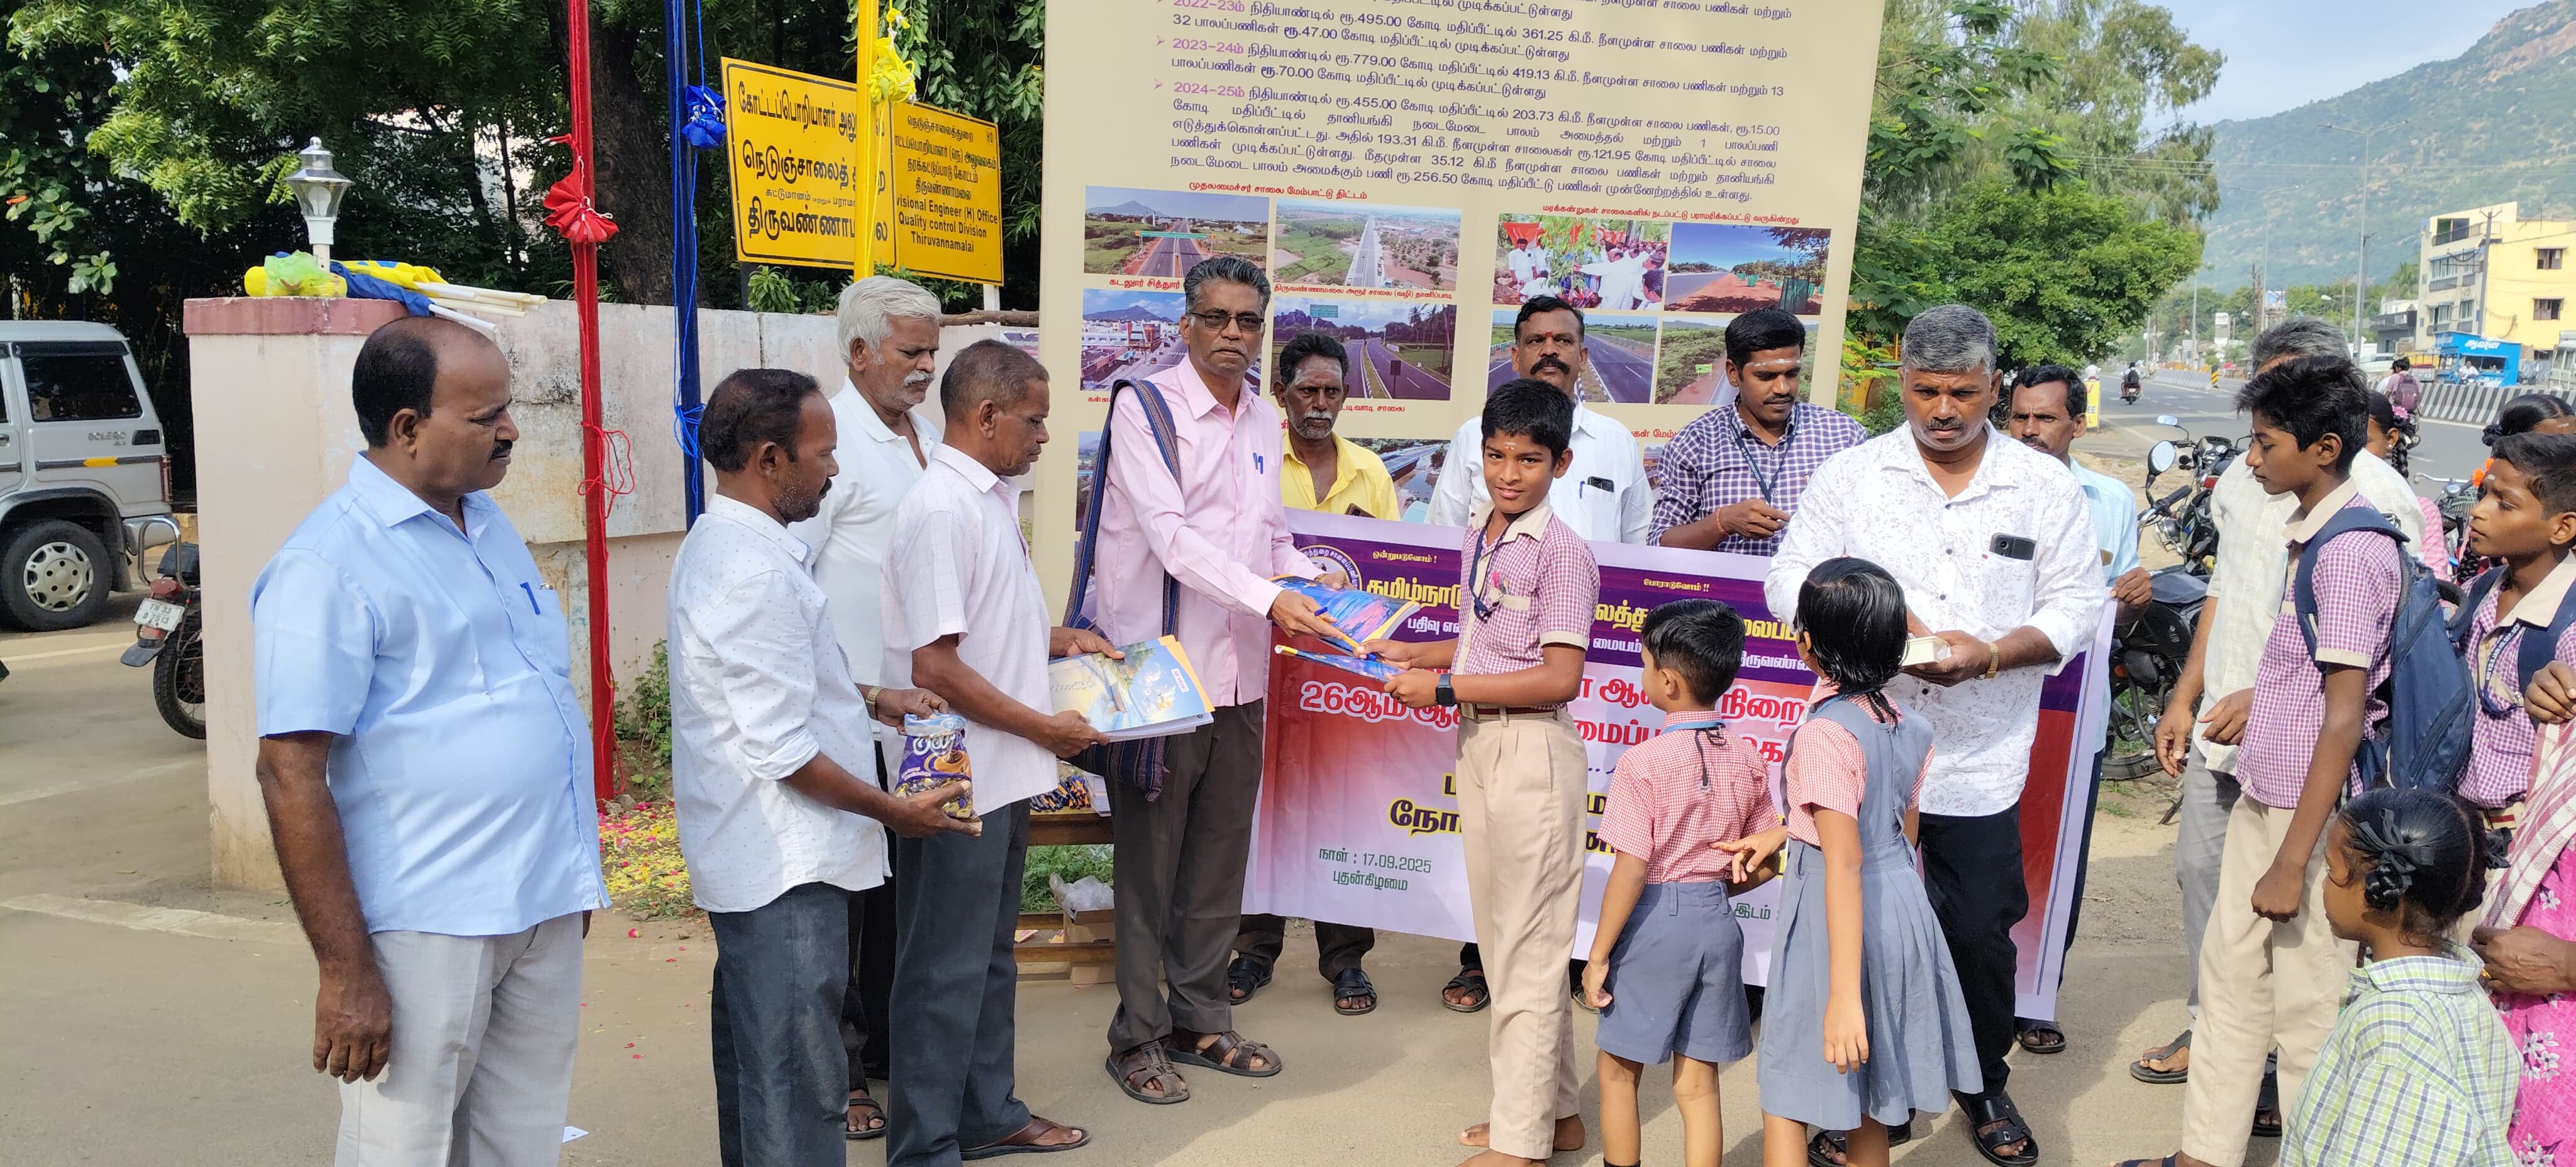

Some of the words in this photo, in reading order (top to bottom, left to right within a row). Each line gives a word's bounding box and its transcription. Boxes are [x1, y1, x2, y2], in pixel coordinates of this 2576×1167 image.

[1706, 1, 1749, 14] பணிகள்
[1754, 6, 1791, 20] மற்றும்
[1173, 14, 1191, 25] 32
[1195, 18, 1279, 33] பாலப்பணிகள்
[1340, 28, 1375, 43] கோடி
[1380, 33, 1451, 50] மதிப்பீட்டில்
[1250, 1, 1334, 21] நிதியாண்டில்
[1407, 16, 1441, 32] கோடி
[1447, 21, 1516, 38] மதிப்பீட்டில்
[1523, 28, 1563, 41] 361.25
[1599, 33, 1655, 49] நீளமுள்ள
[1660, 41, 1696, 51] சாலை
[1702, 42, 1745, 55] பணிகள்
[1750, 47, 1787, 60] மற்றும்
[1172, 58, 1257, 73] பாலப்பணிகள்
[1318, 67, 1352, 83] கோடி
[1357, 72, 1427, 89] மதிப்பீட்டில்
[1248, 43, 1331, 62] நிதியாண்டில்
[1400, 57, 1434, 72] கோடி
[1439, 60, 1508, 77] மதிப்பீட்டில்
[1513, 68, 1550, 79] 419.13
[1583, 72, 1639, 87] நீளமுள்ள
[1643, 80, 1679, 89] சாலை
[1683, 80, 1727, 92] பணிகள்
[1731, 84, 1767, 97] மற்றும்
[1772, 86, 1784, 96] 13
[1249, 86, 1331, 105] நிதியாண்டில்
[1401, 99, 1435, 114] கோடி
[1440, 102, 1508, 119] மதிப்பீட்டில்
[1513, 109, 1554, 121] 203.73
[1587, 113, 1643, 128] நீளமுள்ள
[1646, 121, 1683, 130] சாலை
[1174, 99, 1210, 114] கோடி
[1233, 104, 1306, 121] மதிப்பீட்டில்
[1327, 112, 1392, 126] தானியங்கி
[1413, 120, 1485, 133] நடைமேடை
[1507, 127, 1539, 137] பாலம்
[1560, 131, 1623, 145] அமைத்தல்
[1643, 135, 1681, 149] மற்றும்
[1701, 138, 1706, 148] 1
[1725, 141, 1778, 152] பாலப்பணி
[1172, 136, 1222, 150] பணிகள்
[1365, 148, 1421, 165] மீதமுள்ள
[1431, 155, 1463, 167] 35.12
[1505, 158, 1562, 174] நீளமுள்ள
[1571, 167, 1608, 175] சாலை
[1618, 167, 1661, 179] பணிகள்
[1670, 170, 1707, 184] மற்றும்
[1716, 172, 1774, 184] தானியங்கி
[1336, 130, 1373, 144] அதில்
[1378, 134, 1416, 146] 193.31
[1452, 138, 1510, 154] நீளமுள்ள
[1515, 146, 1573, 157] சாலைகள்
[1635, 150, 1667, 164] கோடி
[1672, 153, 1736, 167] மதிப்பீட்டில்
[1741, 160, 1776, 168] சாலை
[1170, 155, 1248, 169] நடைமேடை
[1253, 162, 1288, 172] பாலம்
[1292, 164, 1362, 179] அமைக்கும்
[1367, 167, 1392, 179] பணி
[1461, 173, 1494, 187] கோடி
[1499, 176, 1553, 193] மதிப்பீட்டு
[1558, 180, 1602, 192] பணிகள்
[1189, 182, 1252, 192] முதலமைச்சர்
[1336, 189, 1367, 199] திட்டம்
[896, 194, 926, 211] visional
[929, 199, 962, 218] Engineer
[964, 206, 975, 223] (H)
[977, 209, 998, 224] Office
[899, 211, 927, 231] Quality
[930, 219, 957, 233] control
[958, 221, 987, 238] Division
[911, 230, 975, 253] Thiruvannamalai
[1274, 284, 1344, 294] திருவண்ணாமலை
[150, 604, 160, 612] TN
[162, 606, 172, 614] 33
[1319, 847, 1348, 863] நாள்
[1363, 853, 1431, 873] 17.09.2025
[1333, 870, 1408, 890] புதன்கிழமை
